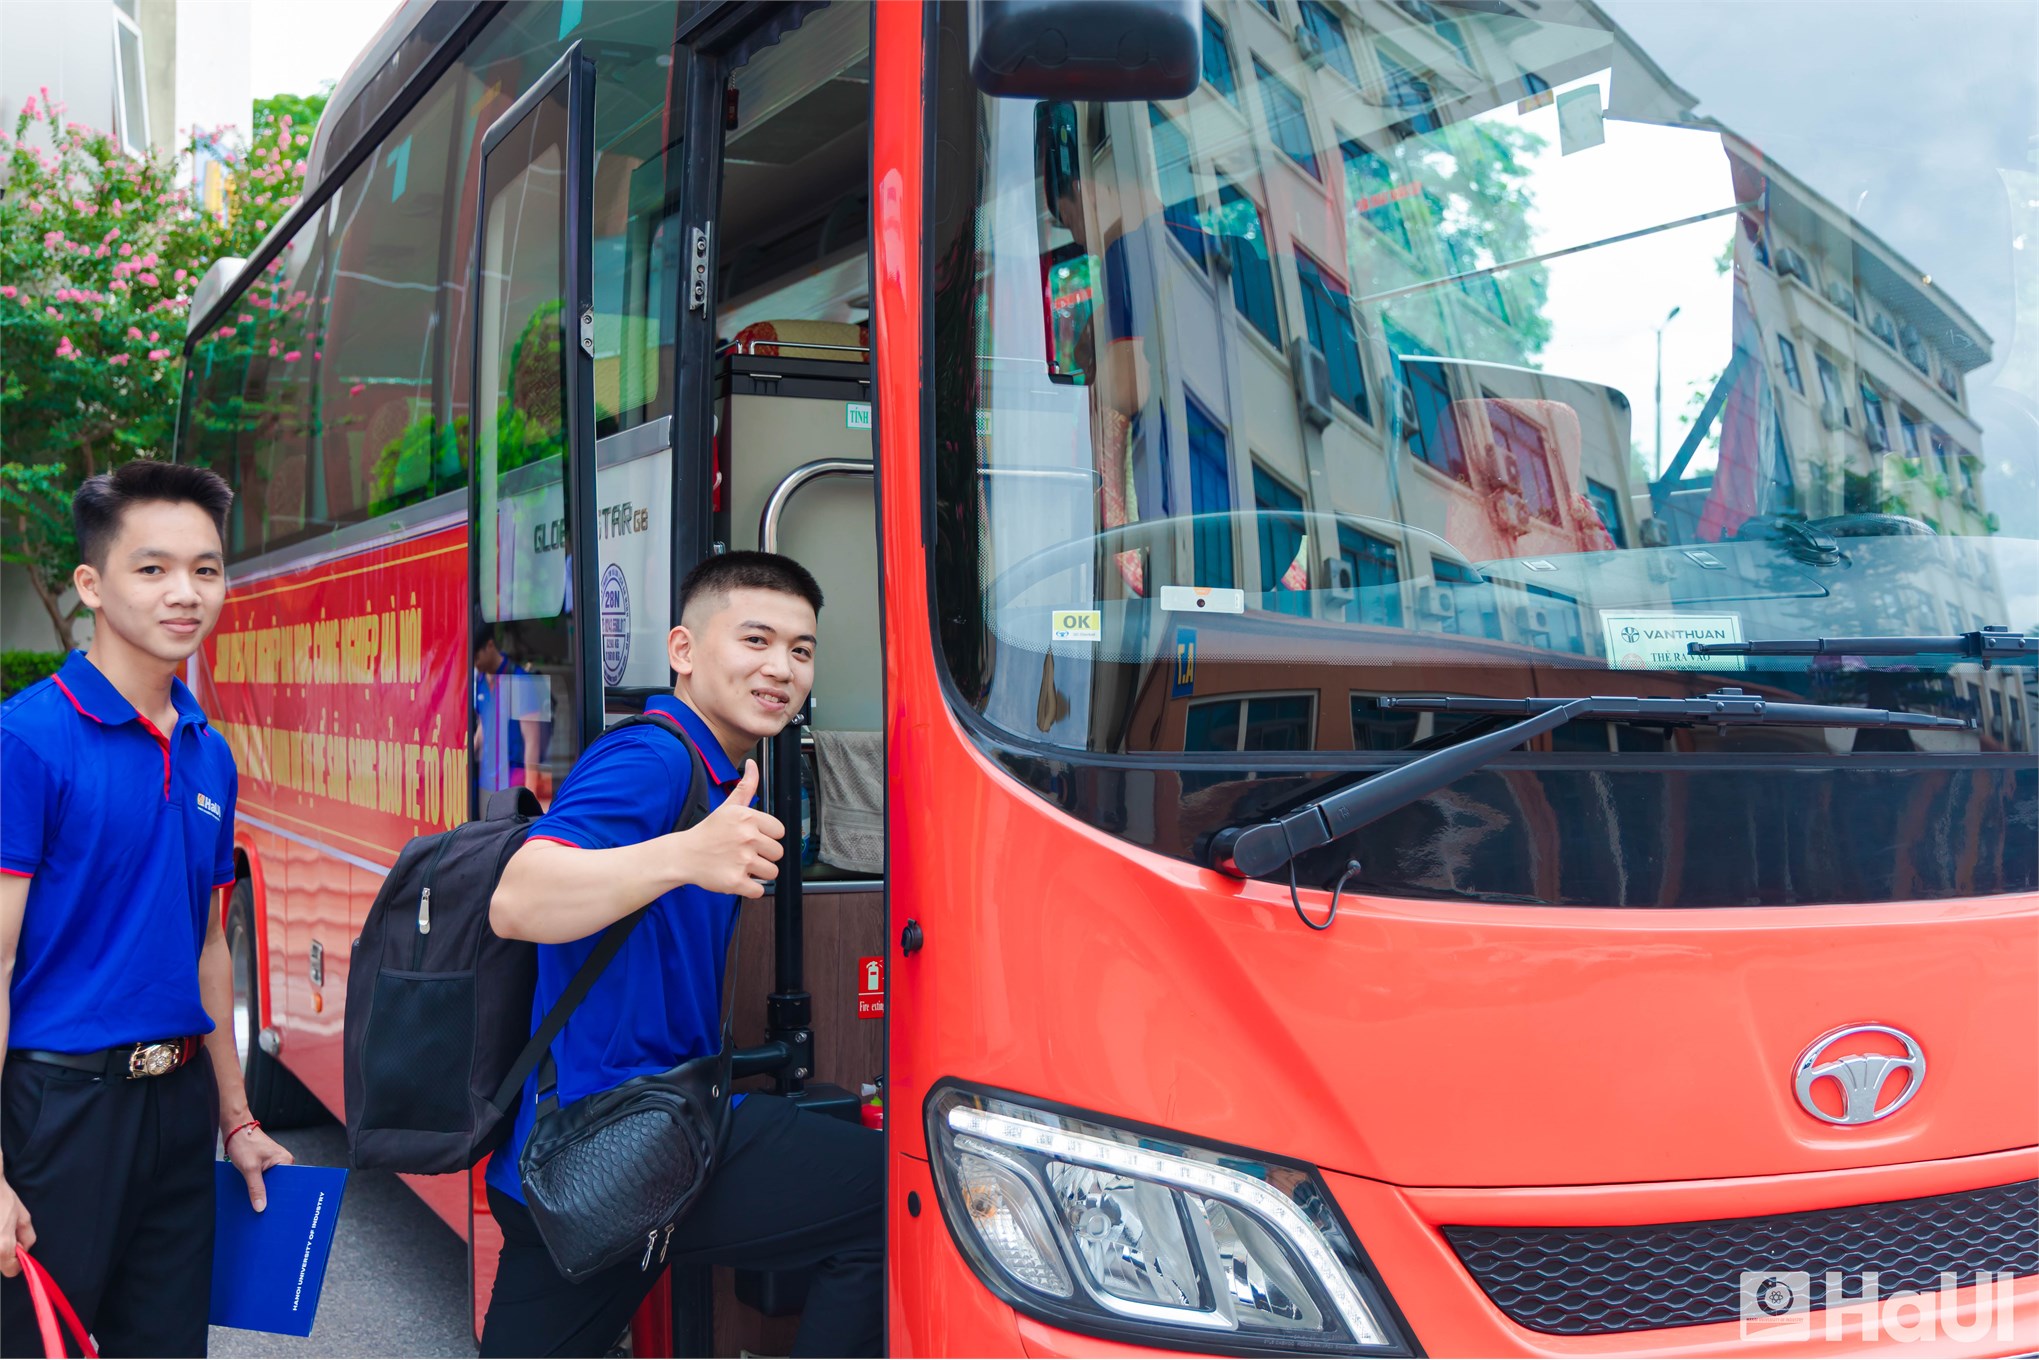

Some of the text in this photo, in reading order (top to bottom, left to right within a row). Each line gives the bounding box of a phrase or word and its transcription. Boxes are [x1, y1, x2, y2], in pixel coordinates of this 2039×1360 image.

[598, 501, 633, 540] TAR
[605, 590, 620, 609] 28N
[1063, 615, 1090, 629] OK
[1643, 630, 1725, 640] VANTHUAN
[313, 607, 340, 684] CÔNG
[341, 600, 379, 700] NGHIỆP
[381, 595, 397, 683] HÀ
[400, 591, 422, 701] NỘI
[1674, 652, 1687, 662] RA
[348, 723, 377, 811] SÀNG
[379, 716, 402, 817] BẢO
[405, 727, 421, 837] VỆ
[423, 714, 440, 826] TỔ
[443, 731, 468, 831] QU
[860, 1001, 869, 1012] Fire
[292, 1191, 325, 1311] HANOI UNIVERSITY OF INDUSTRY
